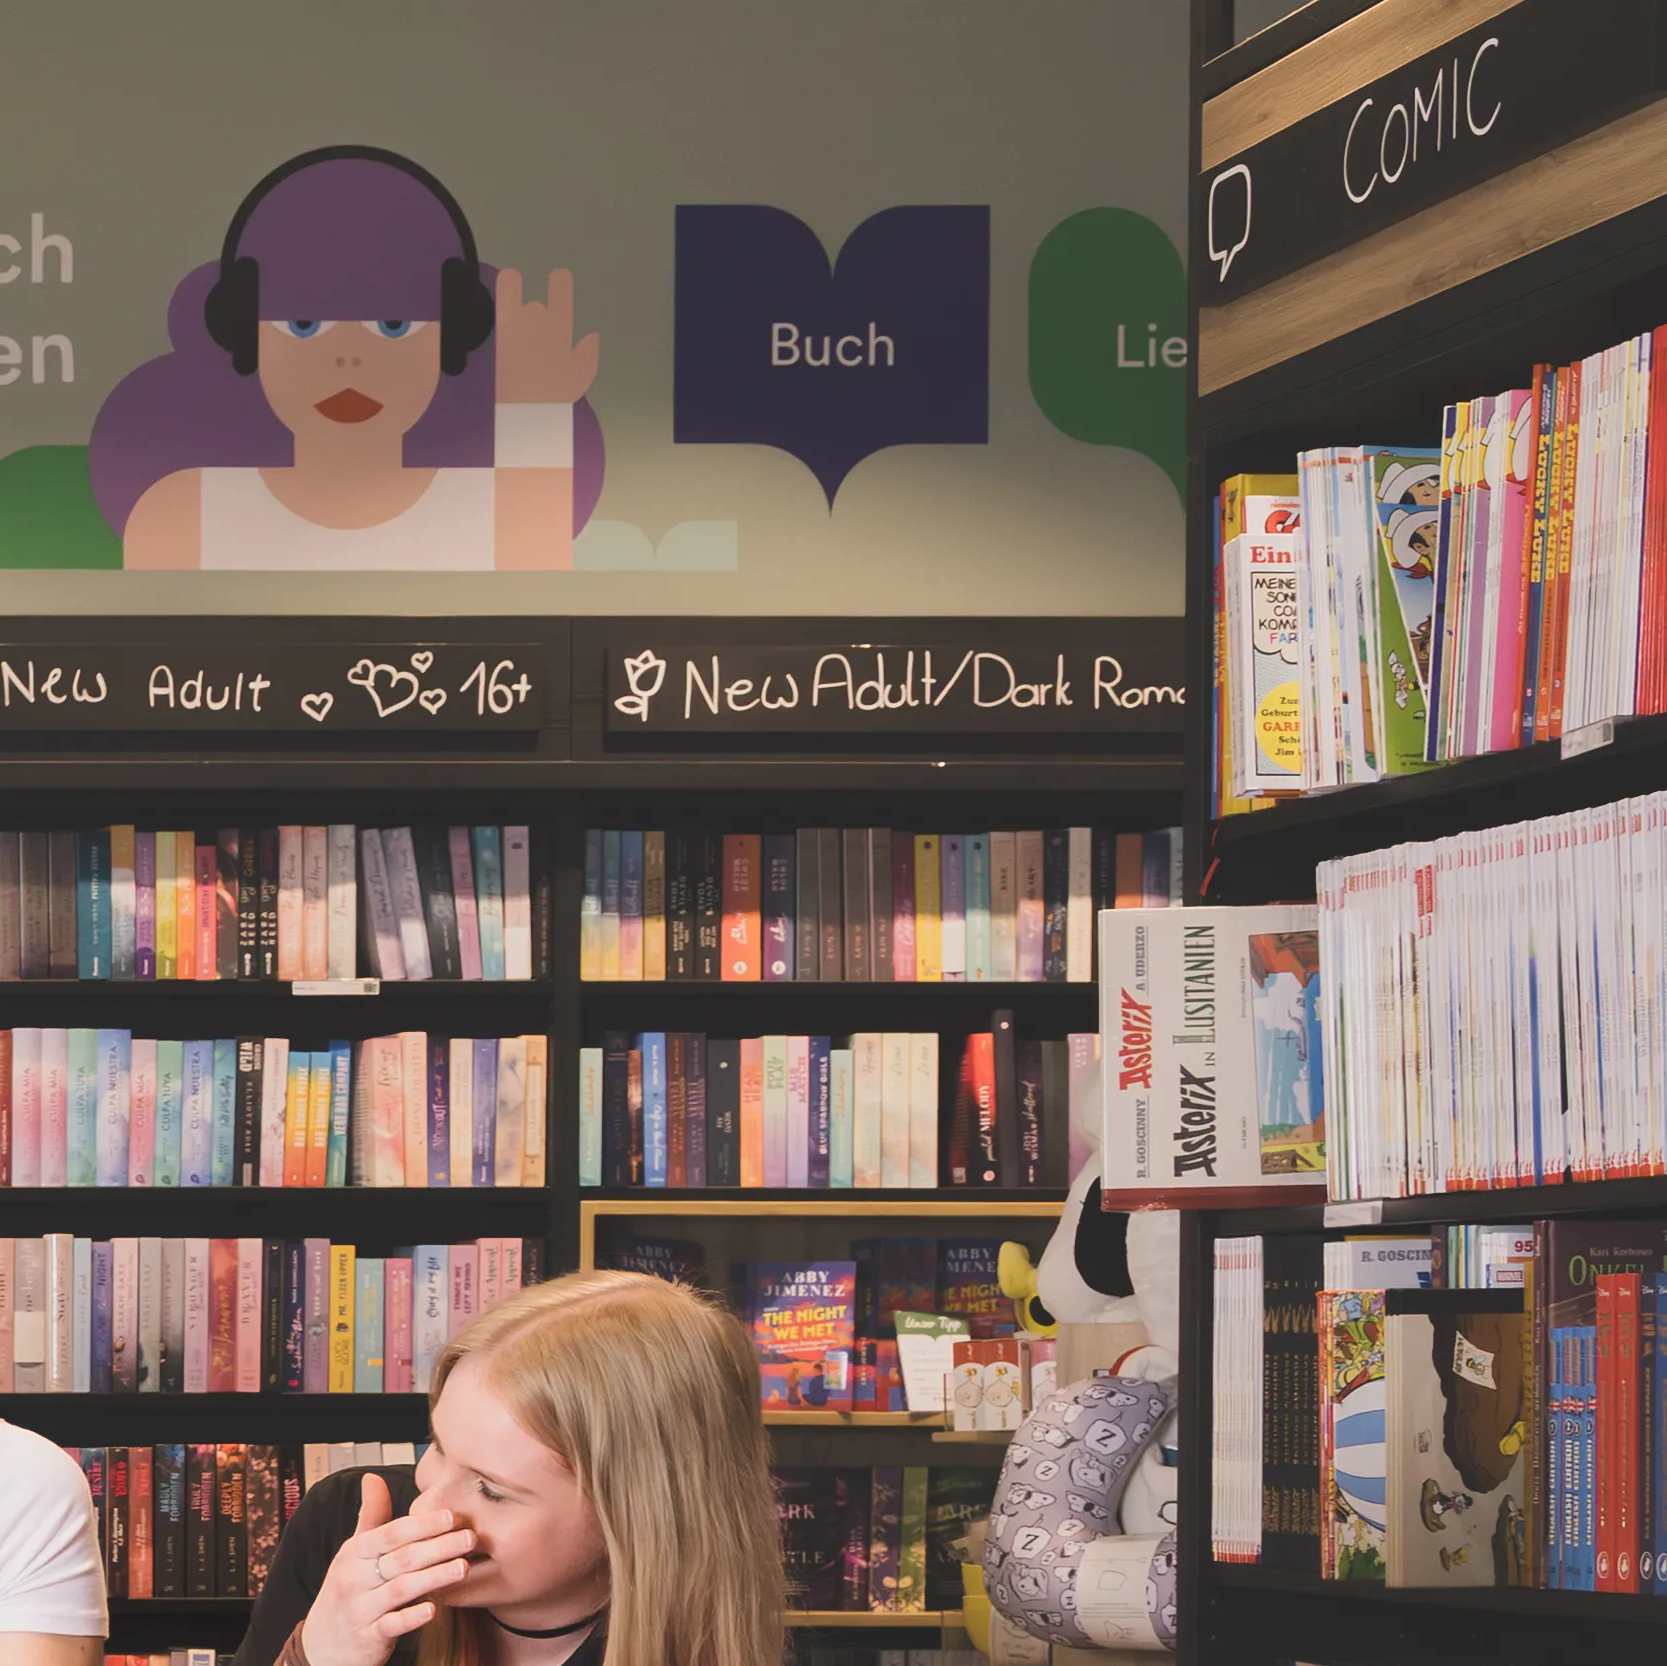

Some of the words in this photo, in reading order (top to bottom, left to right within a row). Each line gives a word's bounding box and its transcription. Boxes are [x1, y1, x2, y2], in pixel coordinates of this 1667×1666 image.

[1343, 37, 1503, 204] COMIC
[772, 322, 894, 366] Buch
[1250, 545, 1292, 564] Ein
[1, 661, 106, 706] New
[149, 665, 270, 712] Adult
[460, 660, 531, 715] 16+
[1135, 926, 1146, 978] UDERZO
[1172, 926, 1216, 1045] LUSITANIEN
[1119, 987, 1153, 1090] Asterix
[1136, 1098, 1147, 1164] GOSCINNY
[1173, 1064, 1218, 1177] Asterix
[1514, 1240, 1534, 1253] 95
[764, 1284, 846, 1298] JIMENEZ
[781, 1271, 829, 1284] ABBY
[763, 1310, 799, 1326] THE
[802, 1305, 848, 1324] NIGHT
[773, 1326, 799, 1340] WE
[802, 1323, 835, 1338] MET
[939, 1314, 962, 1334] Tipp
